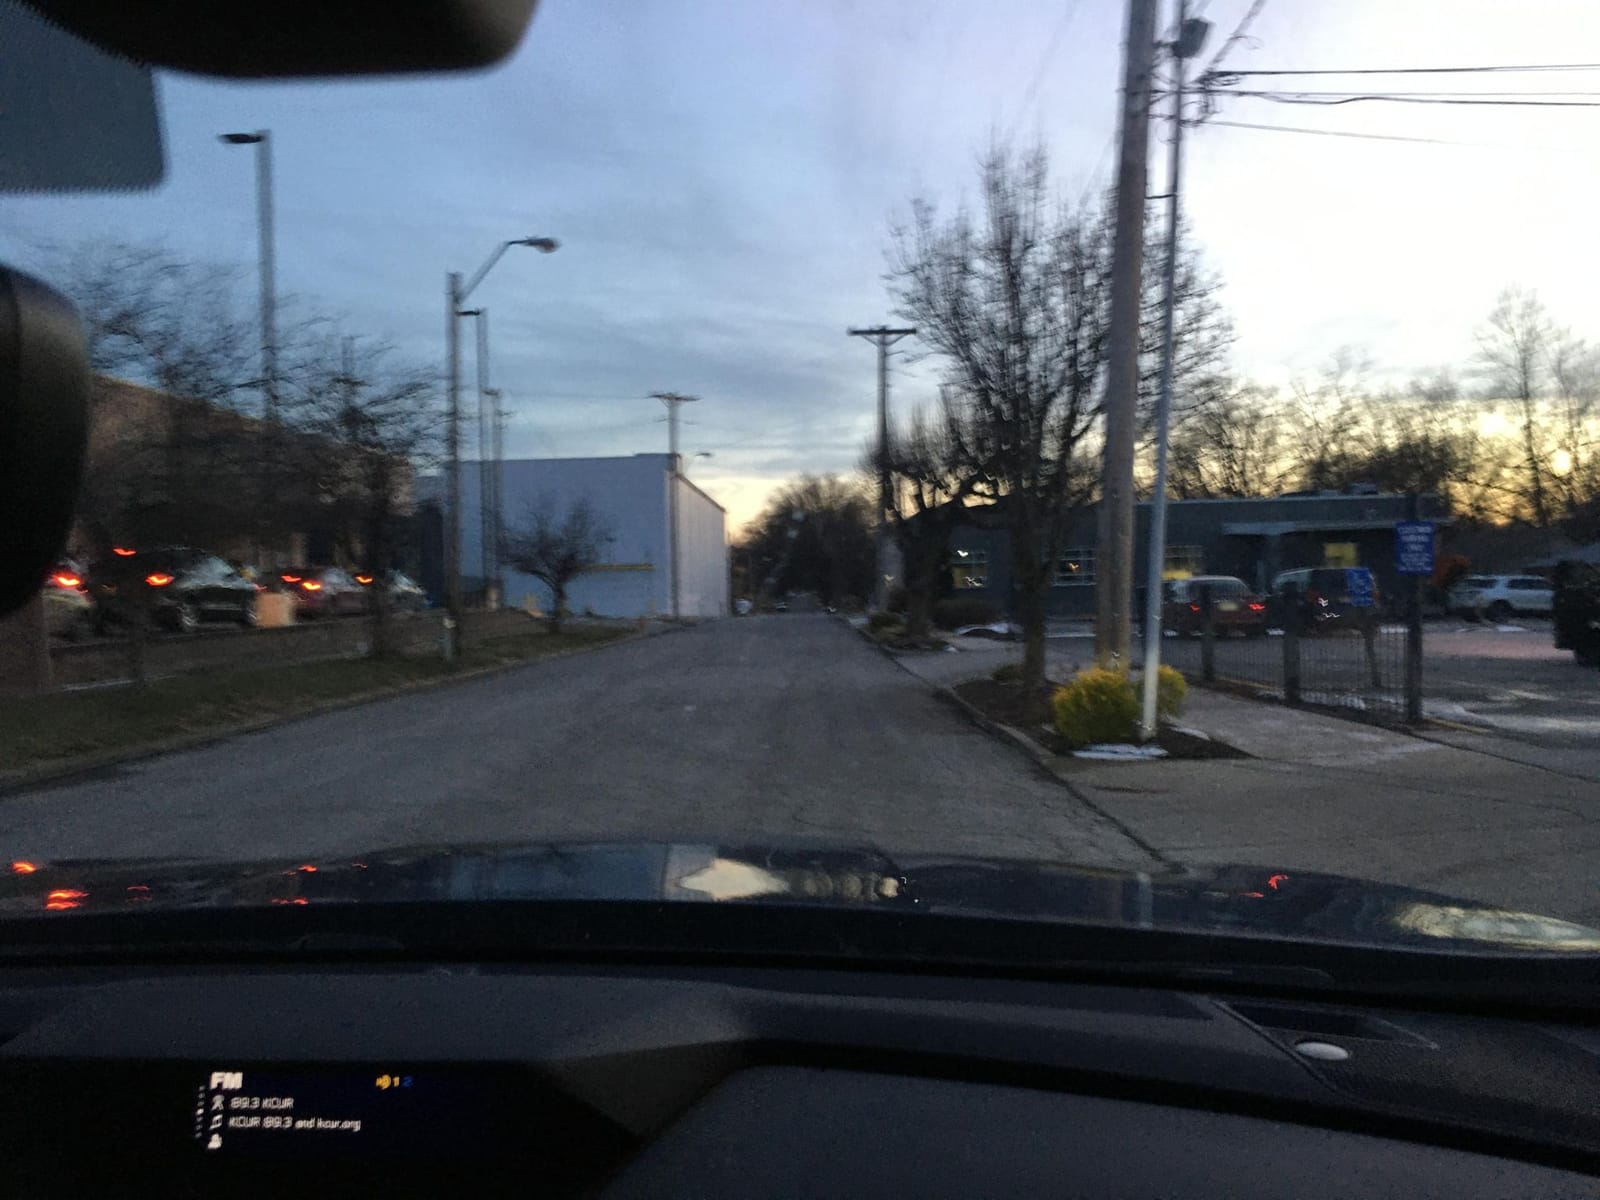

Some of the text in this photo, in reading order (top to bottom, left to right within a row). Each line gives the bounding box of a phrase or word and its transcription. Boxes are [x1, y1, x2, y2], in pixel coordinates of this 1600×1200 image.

[210, 1071, 244, 1090] FM
[230, 1097, 294, 1109] 89.3 KCUR
[228, 1116, 361, 1132] KCUR 89.3 and kcur.org
